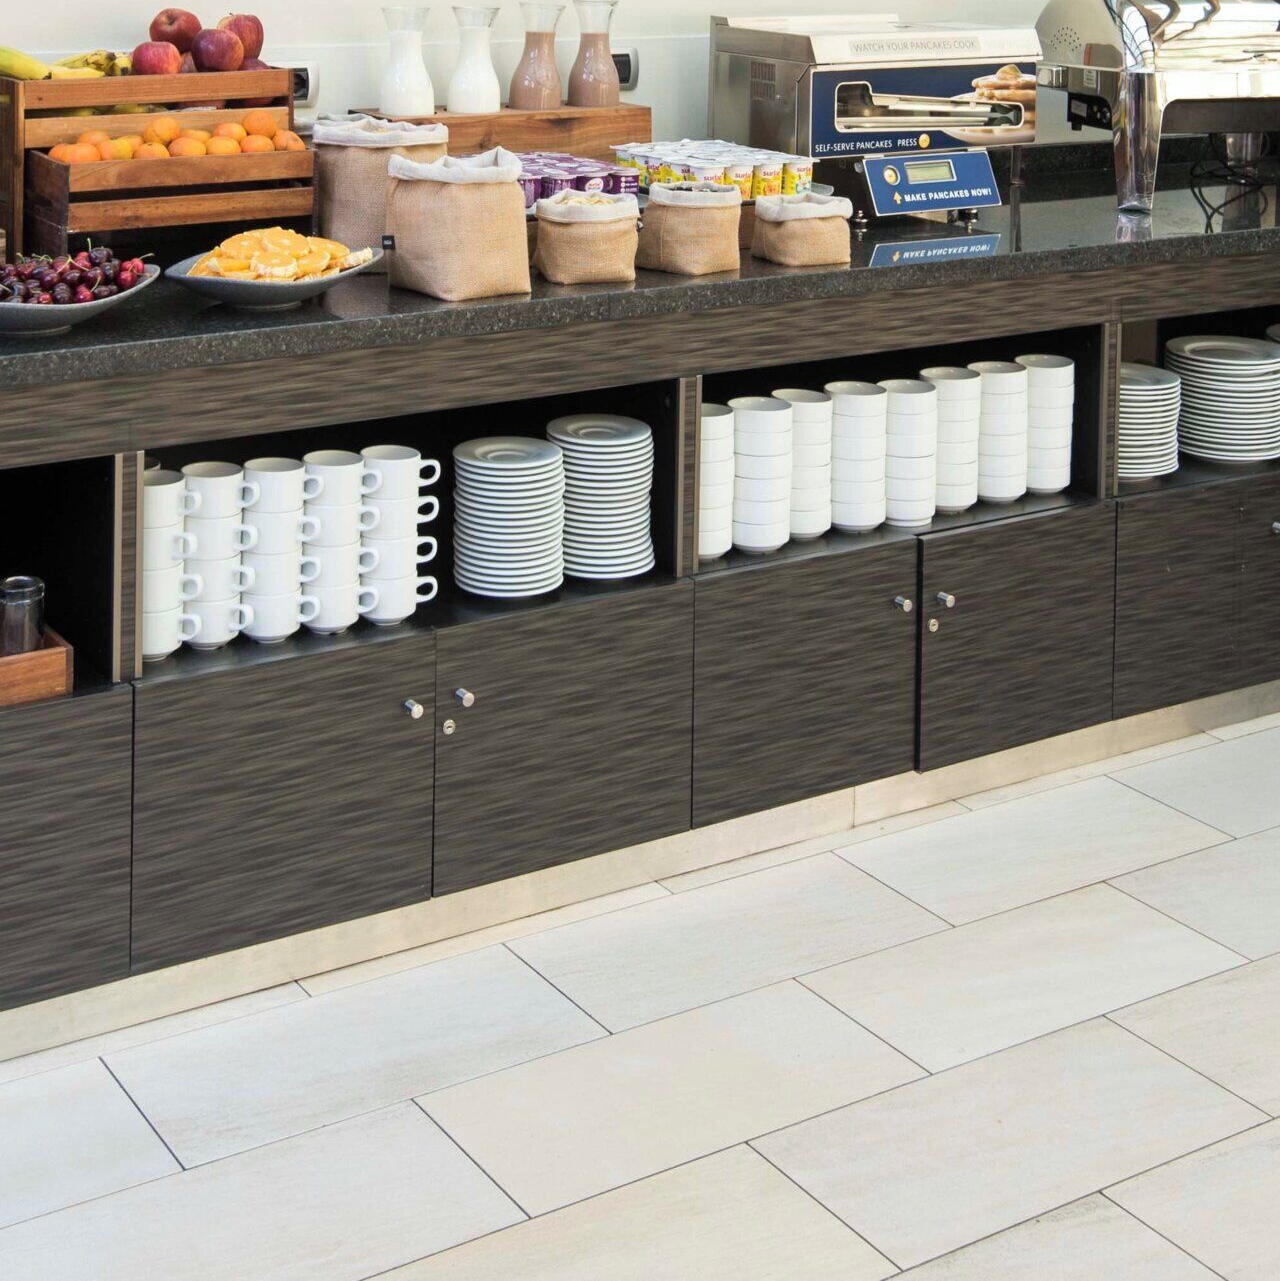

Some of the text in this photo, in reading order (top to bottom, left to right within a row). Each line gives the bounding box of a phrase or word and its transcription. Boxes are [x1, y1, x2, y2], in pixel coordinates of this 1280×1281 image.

[852, 39, 977, 52] WATCH YOUR PANCAKES COOK
[815, 139, 893, 153] SELF-SERVE PANCAKES
[897, 137, 918, 147] PRESS
[904, 187, 992, 202] MAKE PANCAKES NOW!
